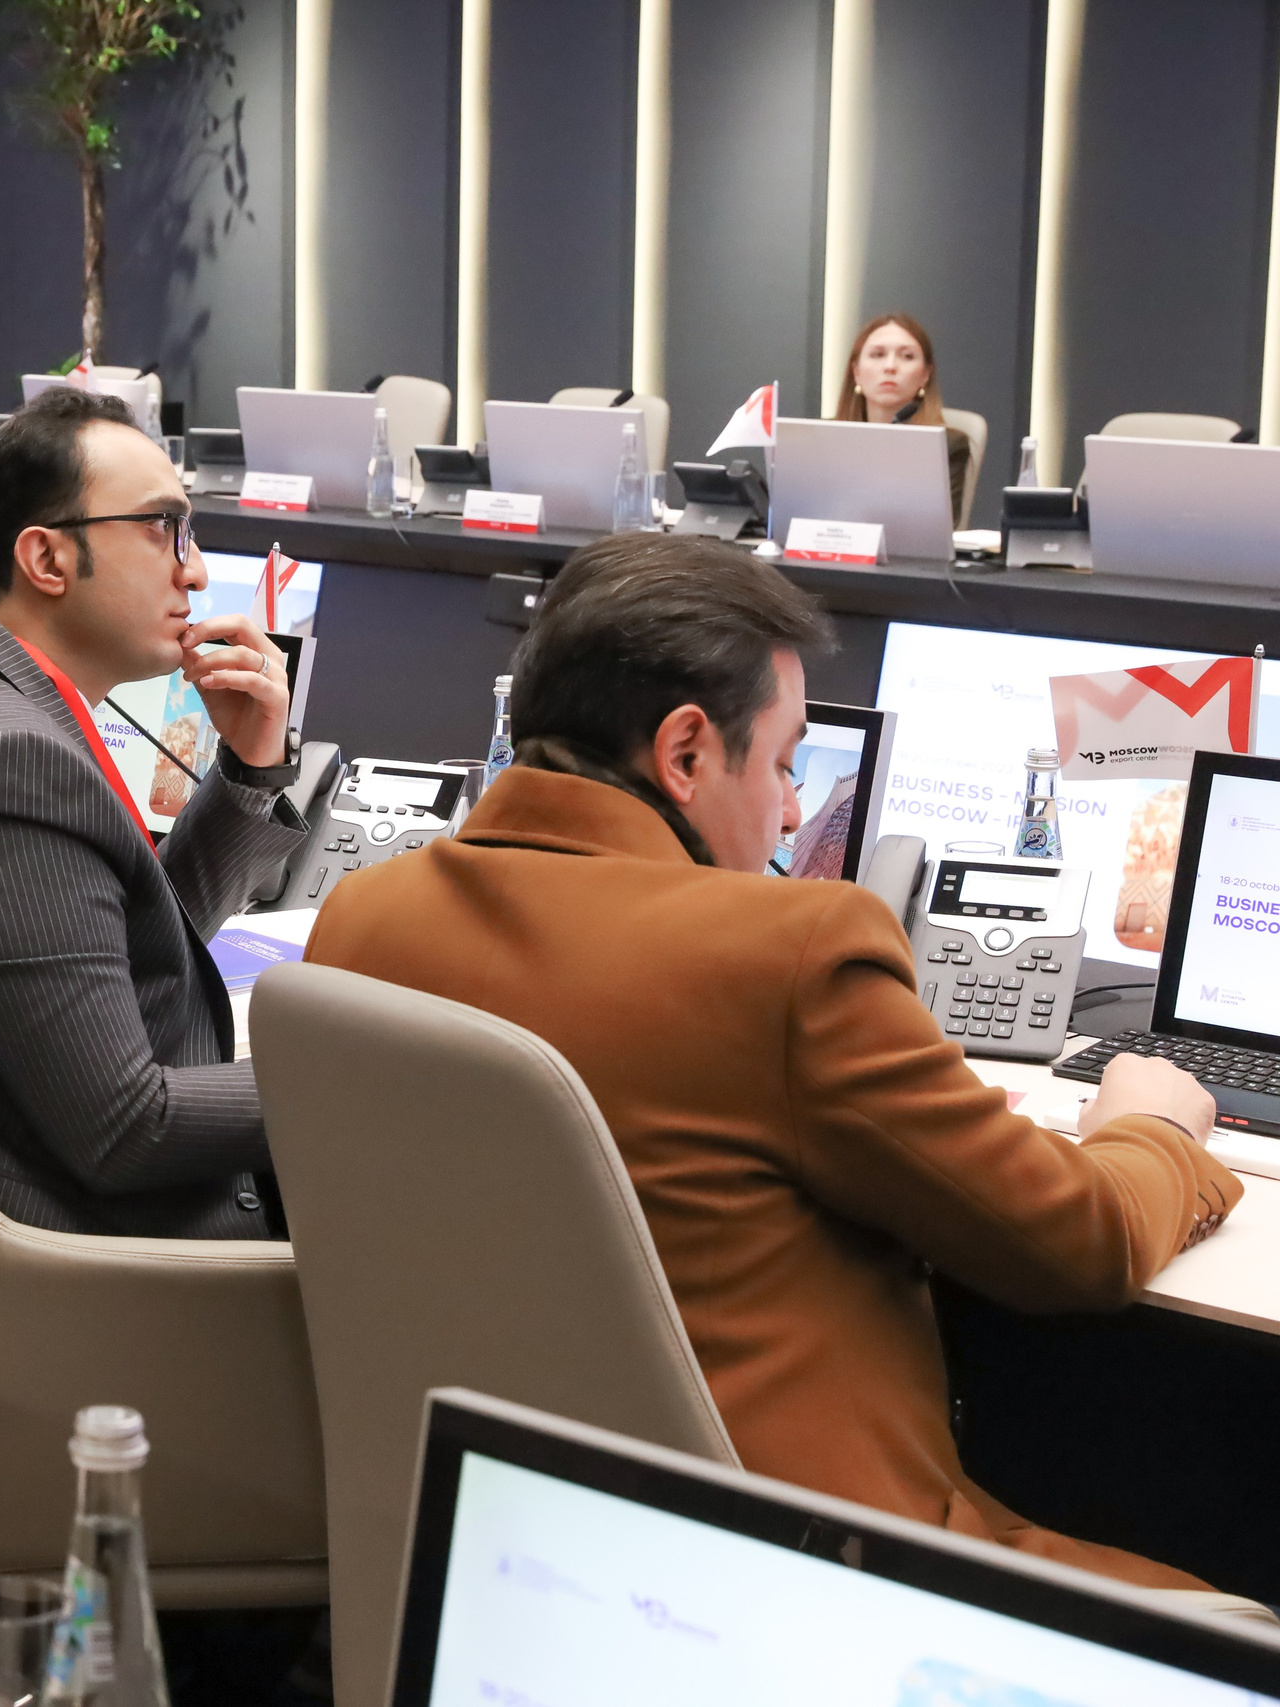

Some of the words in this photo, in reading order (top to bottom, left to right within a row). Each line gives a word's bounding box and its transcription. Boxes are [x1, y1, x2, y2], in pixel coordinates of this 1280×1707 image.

[1109, 746, 1158, 757] MOSCOW
[1110, 756, 1134, 764] export
[891, 774, 994, 801] BUSINESS
[887, 798, 989, 825] MOSCOW
[1220, 875, 1248, 887] 18-20
[1216, 894, 1280, 916] BUSINE
[1213, 913, 1280, 934] MOSCO
